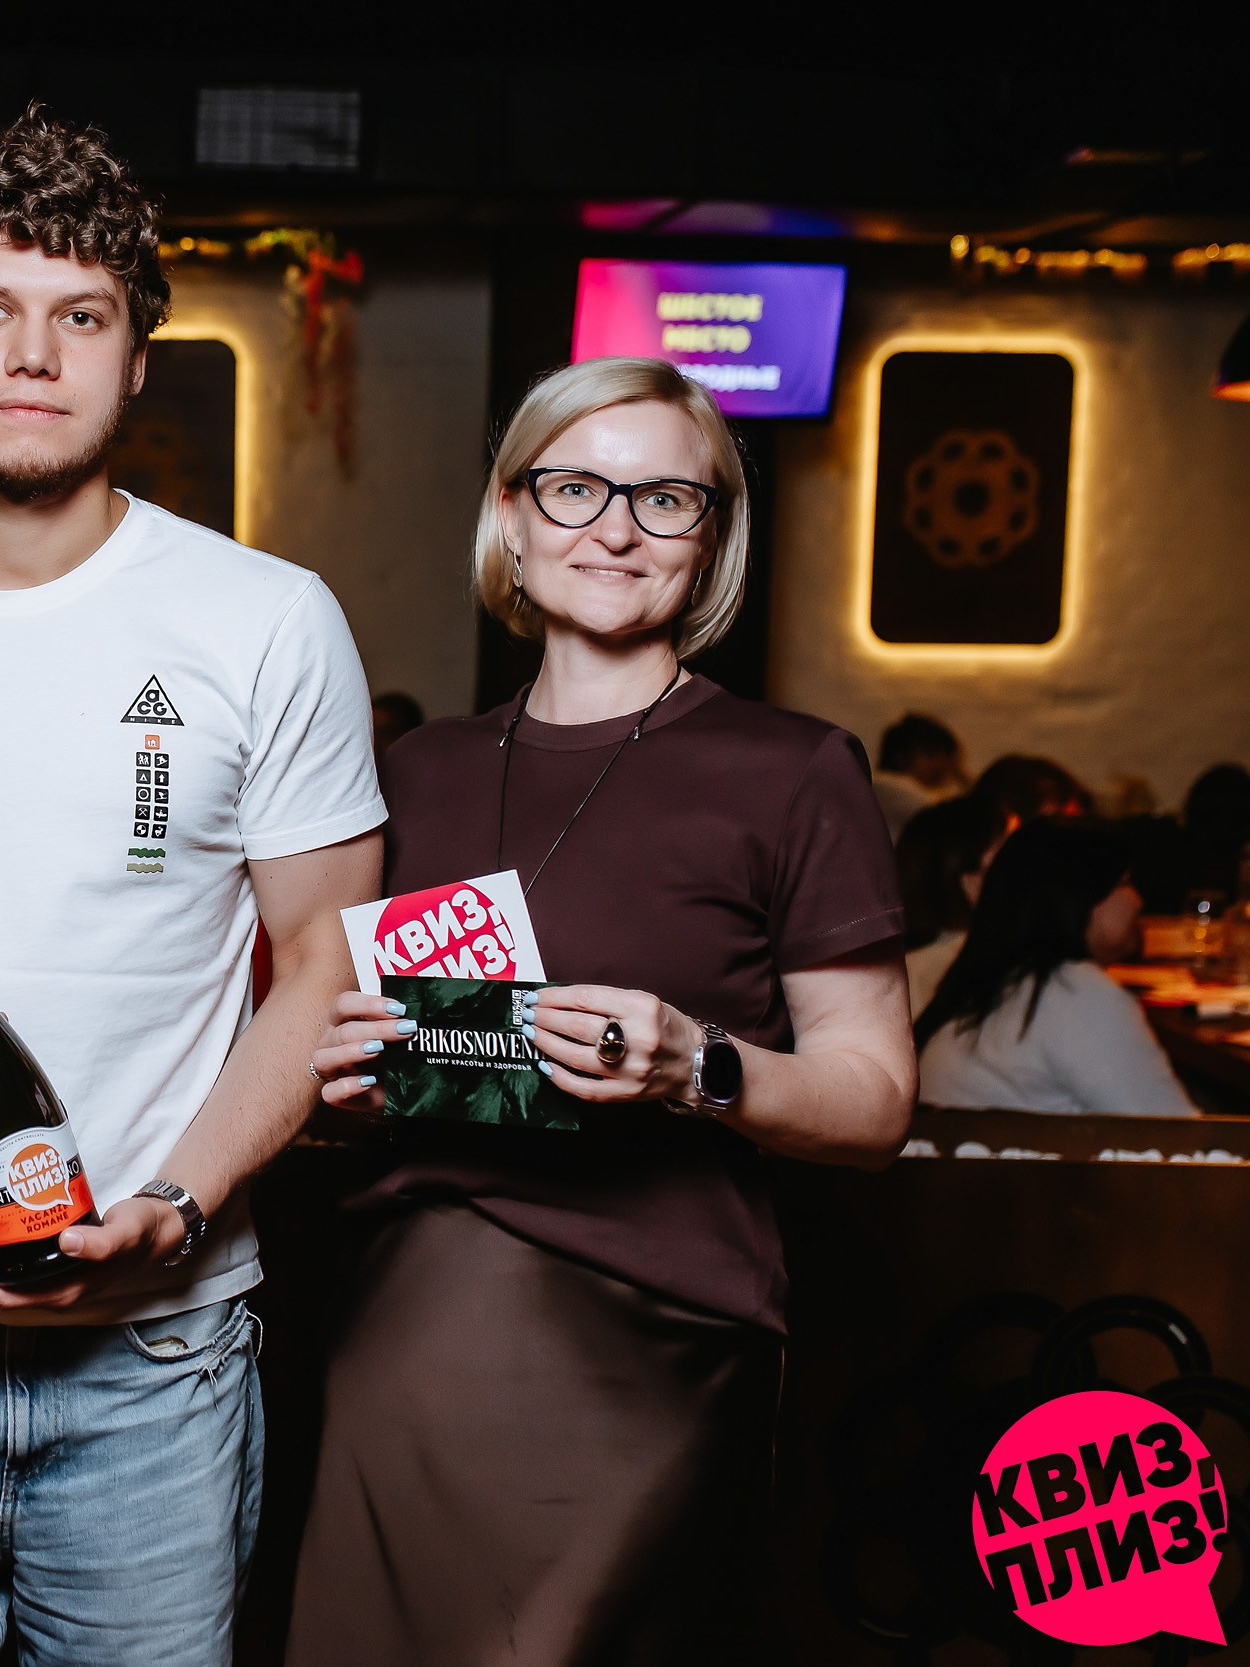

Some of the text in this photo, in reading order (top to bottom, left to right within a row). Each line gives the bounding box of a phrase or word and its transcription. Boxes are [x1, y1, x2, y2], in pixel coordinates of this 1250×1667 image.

[426, 1057, 450, 1066] ЦЕНТР
[451, 1059, 484, 1068] КРАСОТЫ
[493, 1062, 532, 1071] ЗДОРОВЬЯ
[20, 1204, 69, 1225] VACANZE
[27, 1212, 69, 1234] ROMANE
